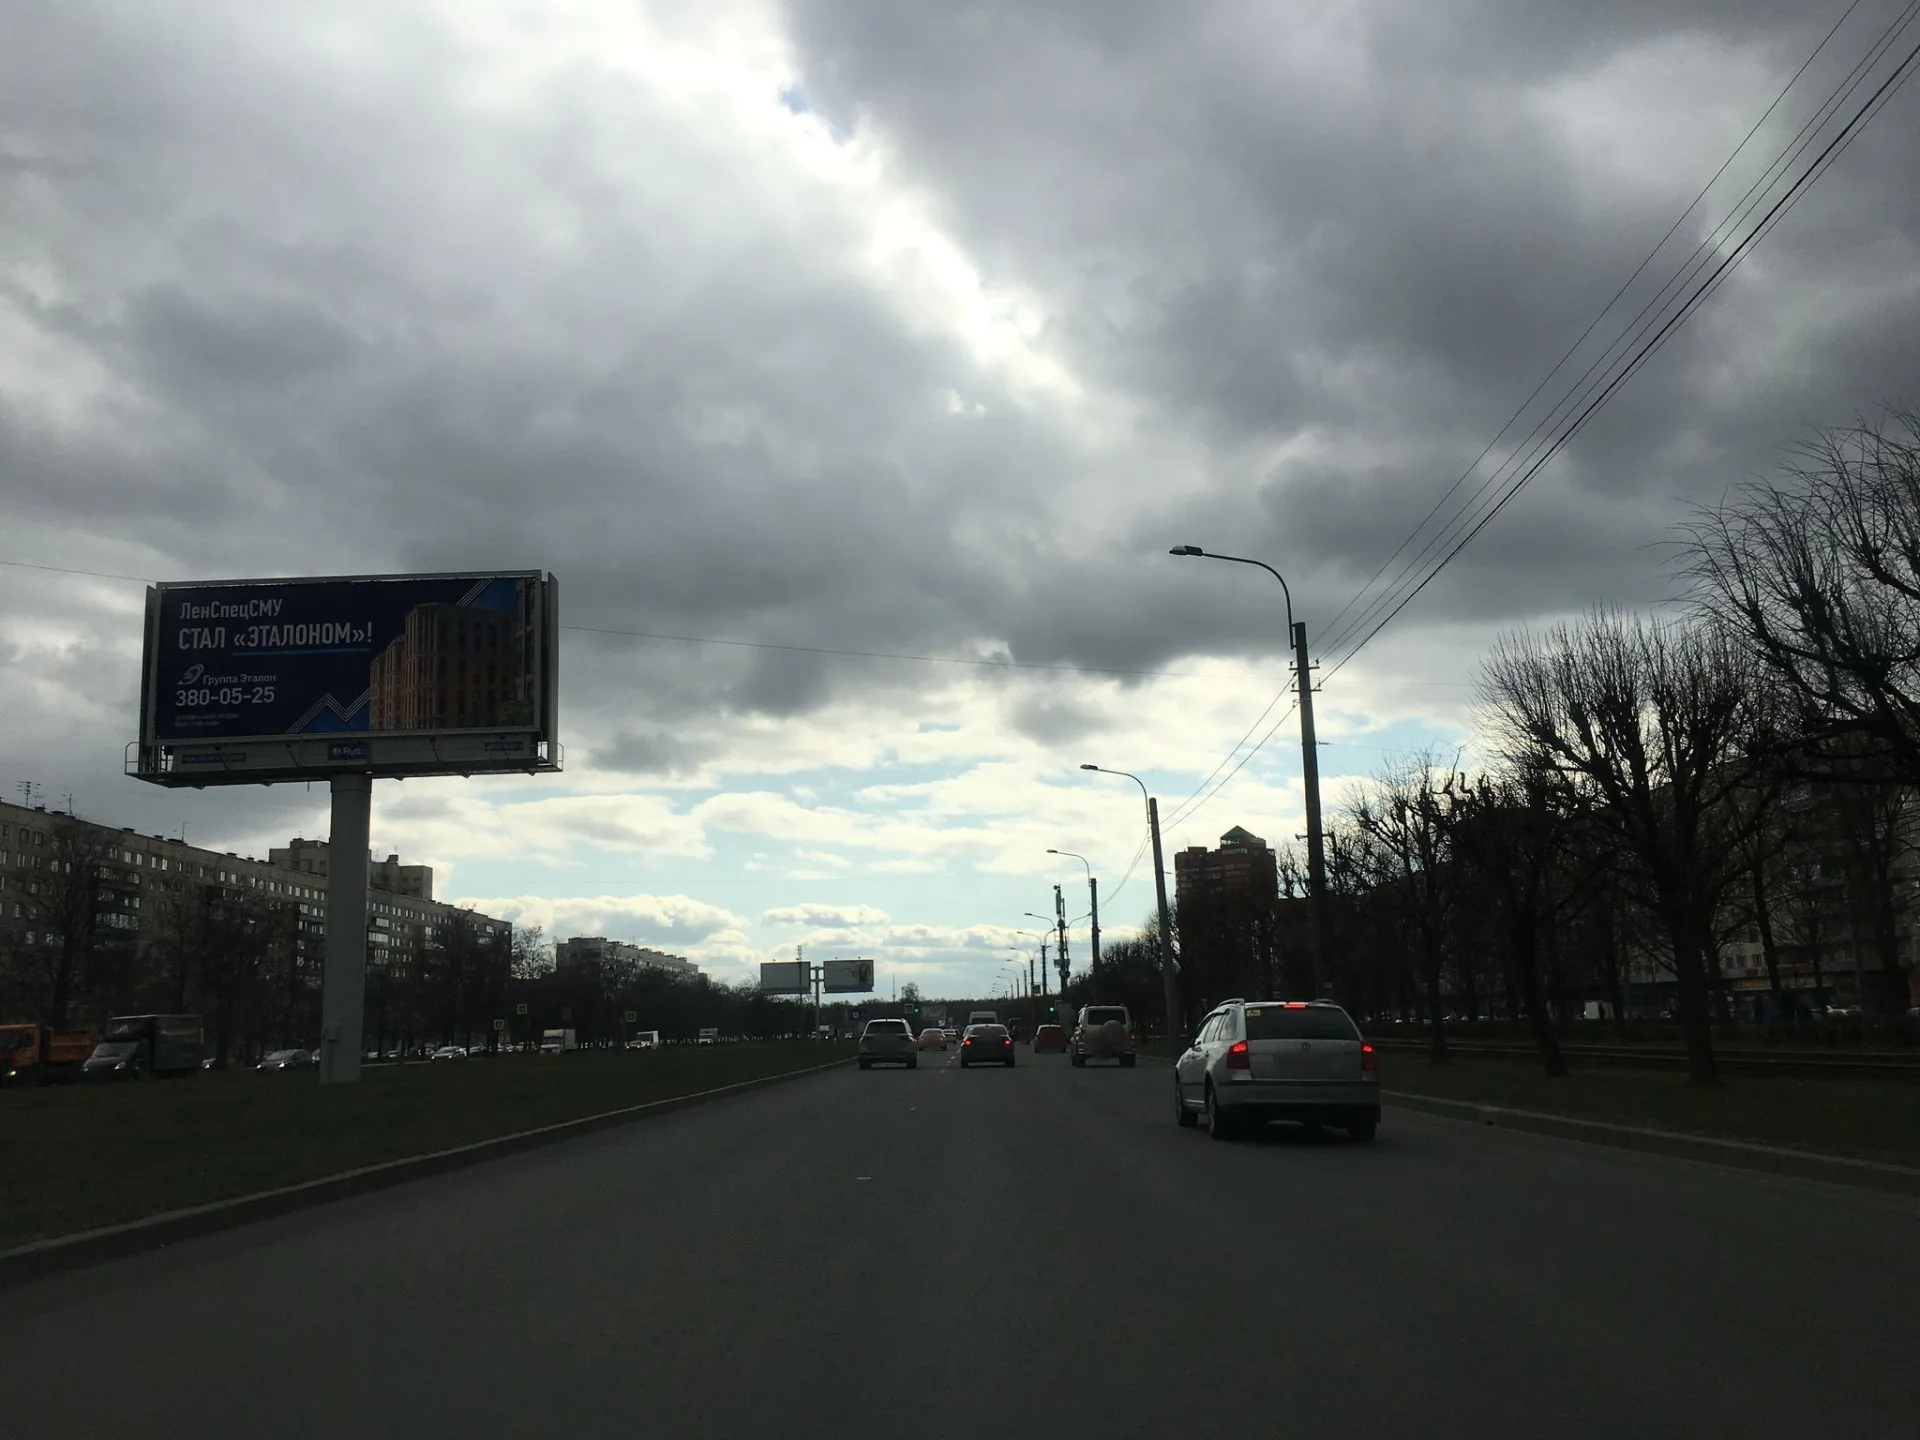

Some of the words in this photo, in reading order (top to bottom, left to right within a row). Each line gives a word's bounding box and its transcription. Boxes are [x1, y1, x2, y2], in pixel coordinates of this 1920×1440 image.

[180, 599, 283, 619] ЛенСпецСМУ
[179, 627, 225, 649] СТАЛ
[233, 622, 372, 647] «ЭТАЛОНОМ»!
[203, 674, 238, 686] Группа
[240, 673, 277, 684] Эталон
[175, 686, 275, 706] 380-05-25
